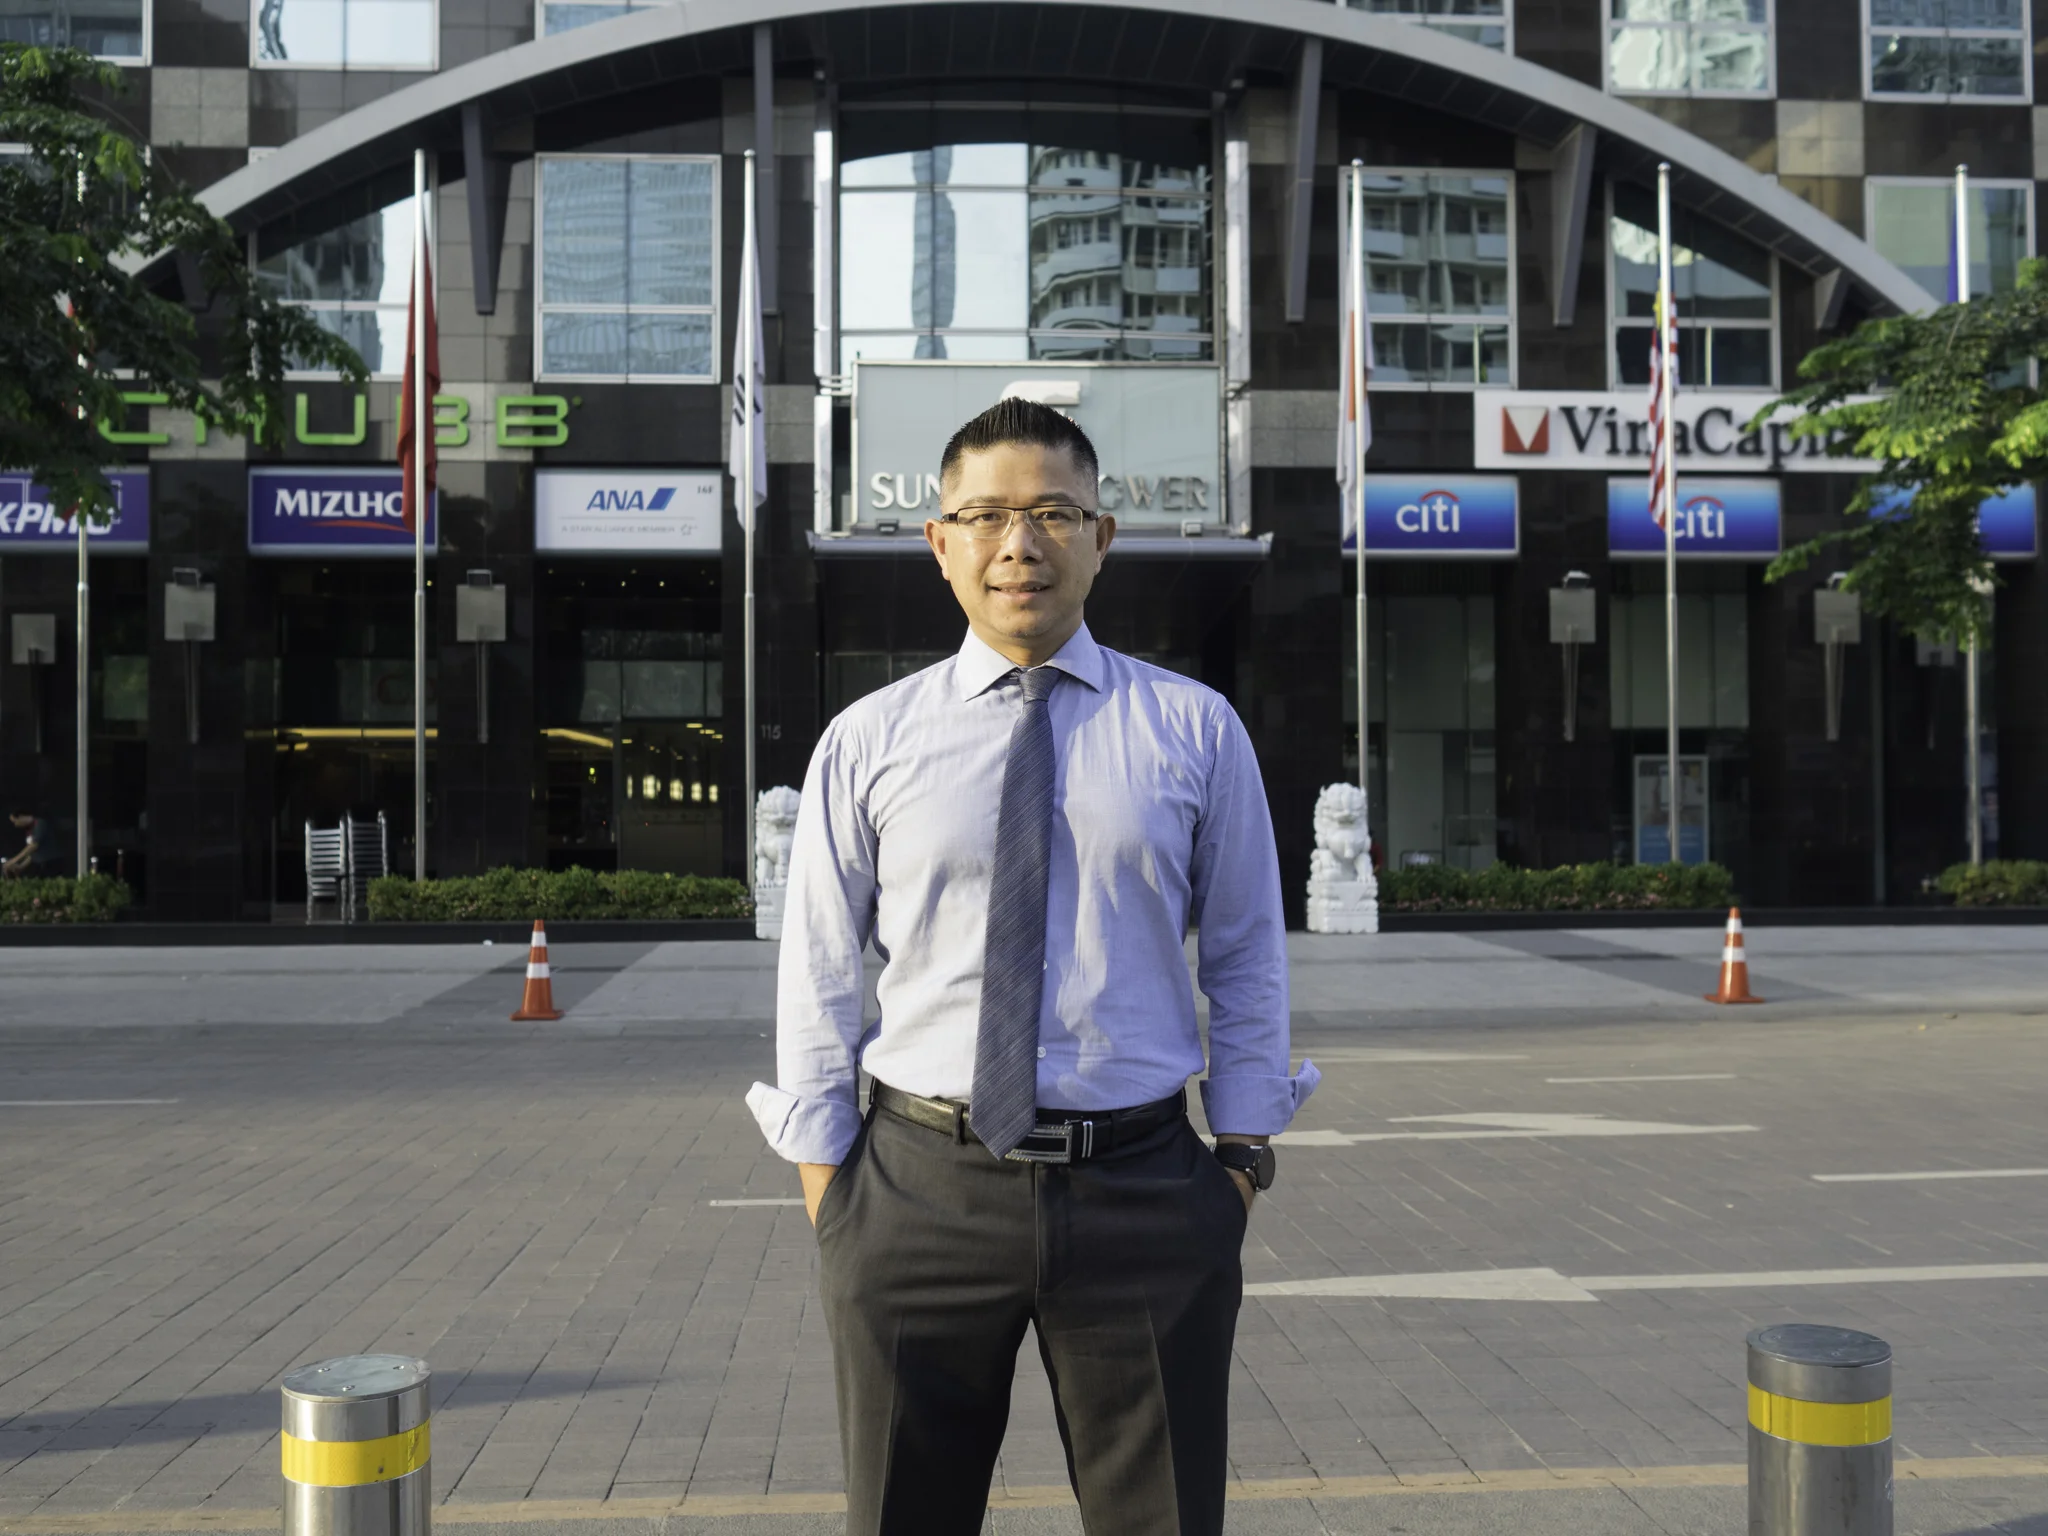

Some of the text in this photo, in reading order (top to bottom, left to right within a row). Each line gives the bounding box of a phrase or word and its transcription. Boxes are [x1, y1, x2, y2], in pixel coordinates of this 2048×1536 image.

[586, 489, 645, 512] ANA
[1097, 474, 1210, 511] OWER
[1396, 496, 1460, 533] citi
